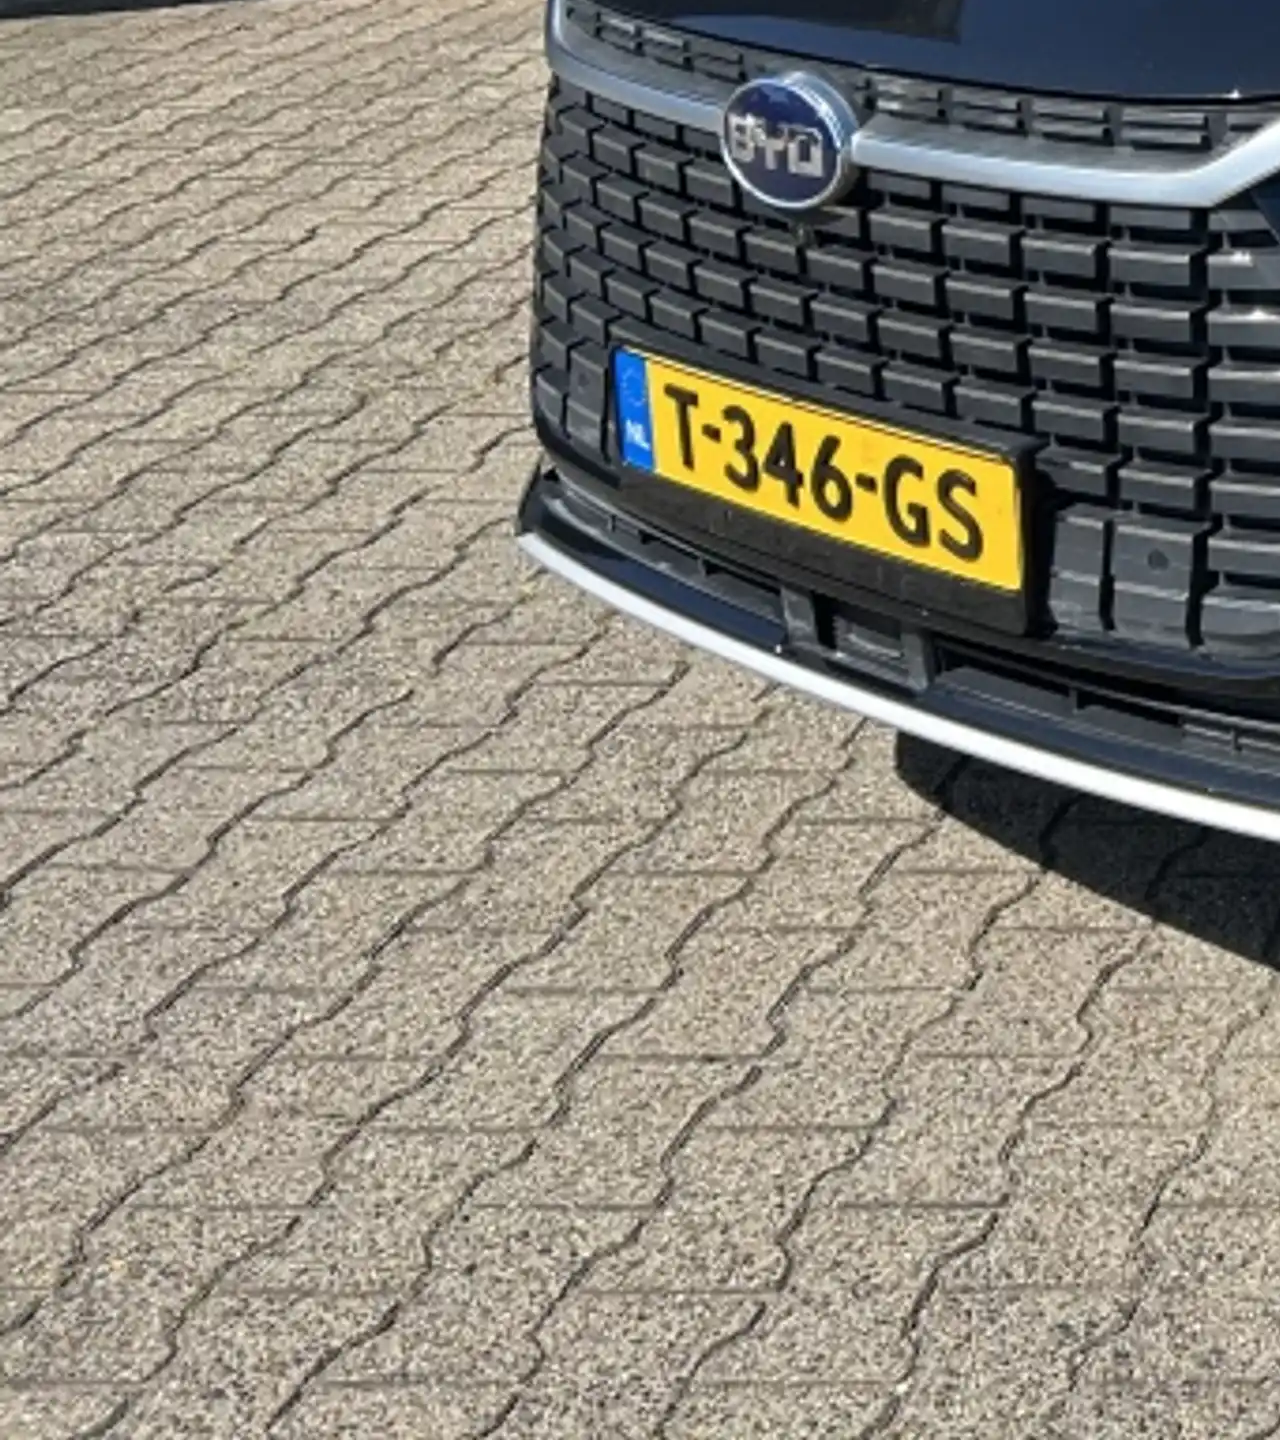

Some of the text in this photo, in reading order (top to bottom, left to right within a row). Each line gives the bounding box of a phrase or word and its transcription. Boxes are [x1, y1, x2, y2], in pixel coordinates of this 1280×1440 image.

[726, 112, 824, 178] BYD
[625, 419, 650, 451] NL
[664, 383, 984, 562] T-346-GS
